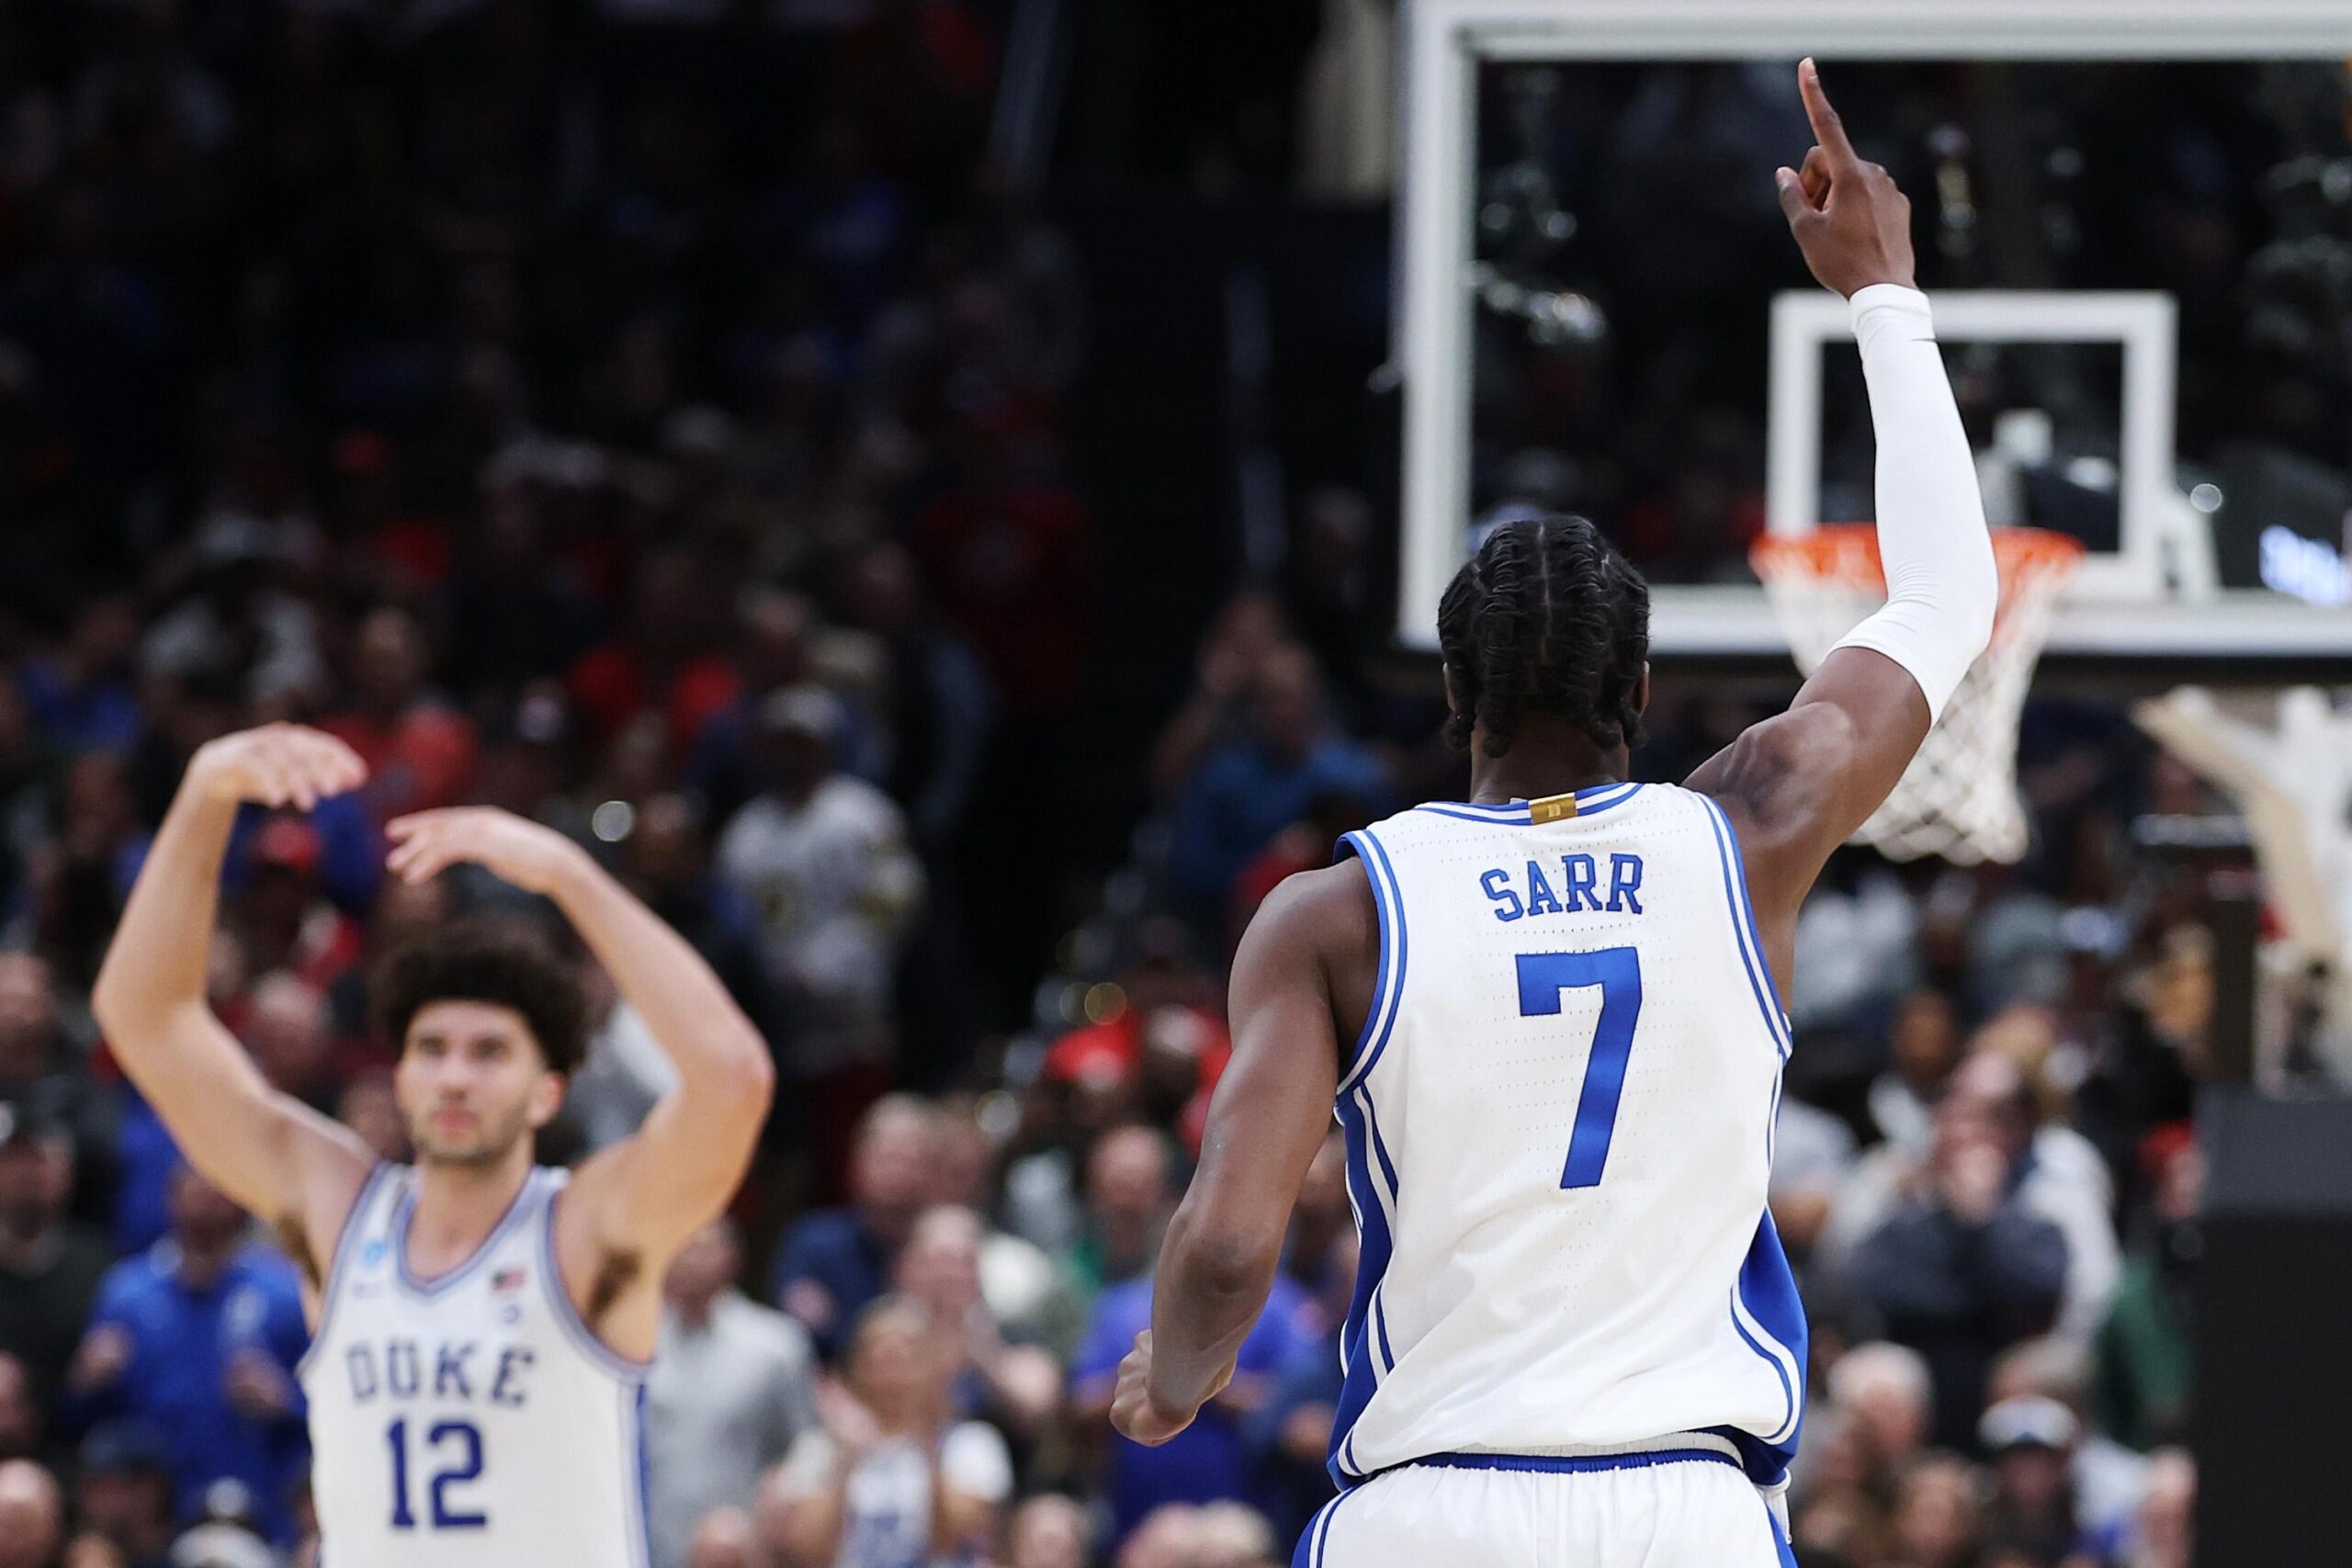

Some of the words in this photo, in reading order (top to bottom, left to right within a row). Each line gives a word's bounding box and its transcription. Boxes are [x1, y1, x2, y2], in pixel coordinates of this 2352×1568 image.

[1479, 853, 1644, 922] SARR
[1515, 946, 1643, 1190] 7
[345, 1337, 536, 1406] DUKE
[387, 1419, 488, 1529] 12
